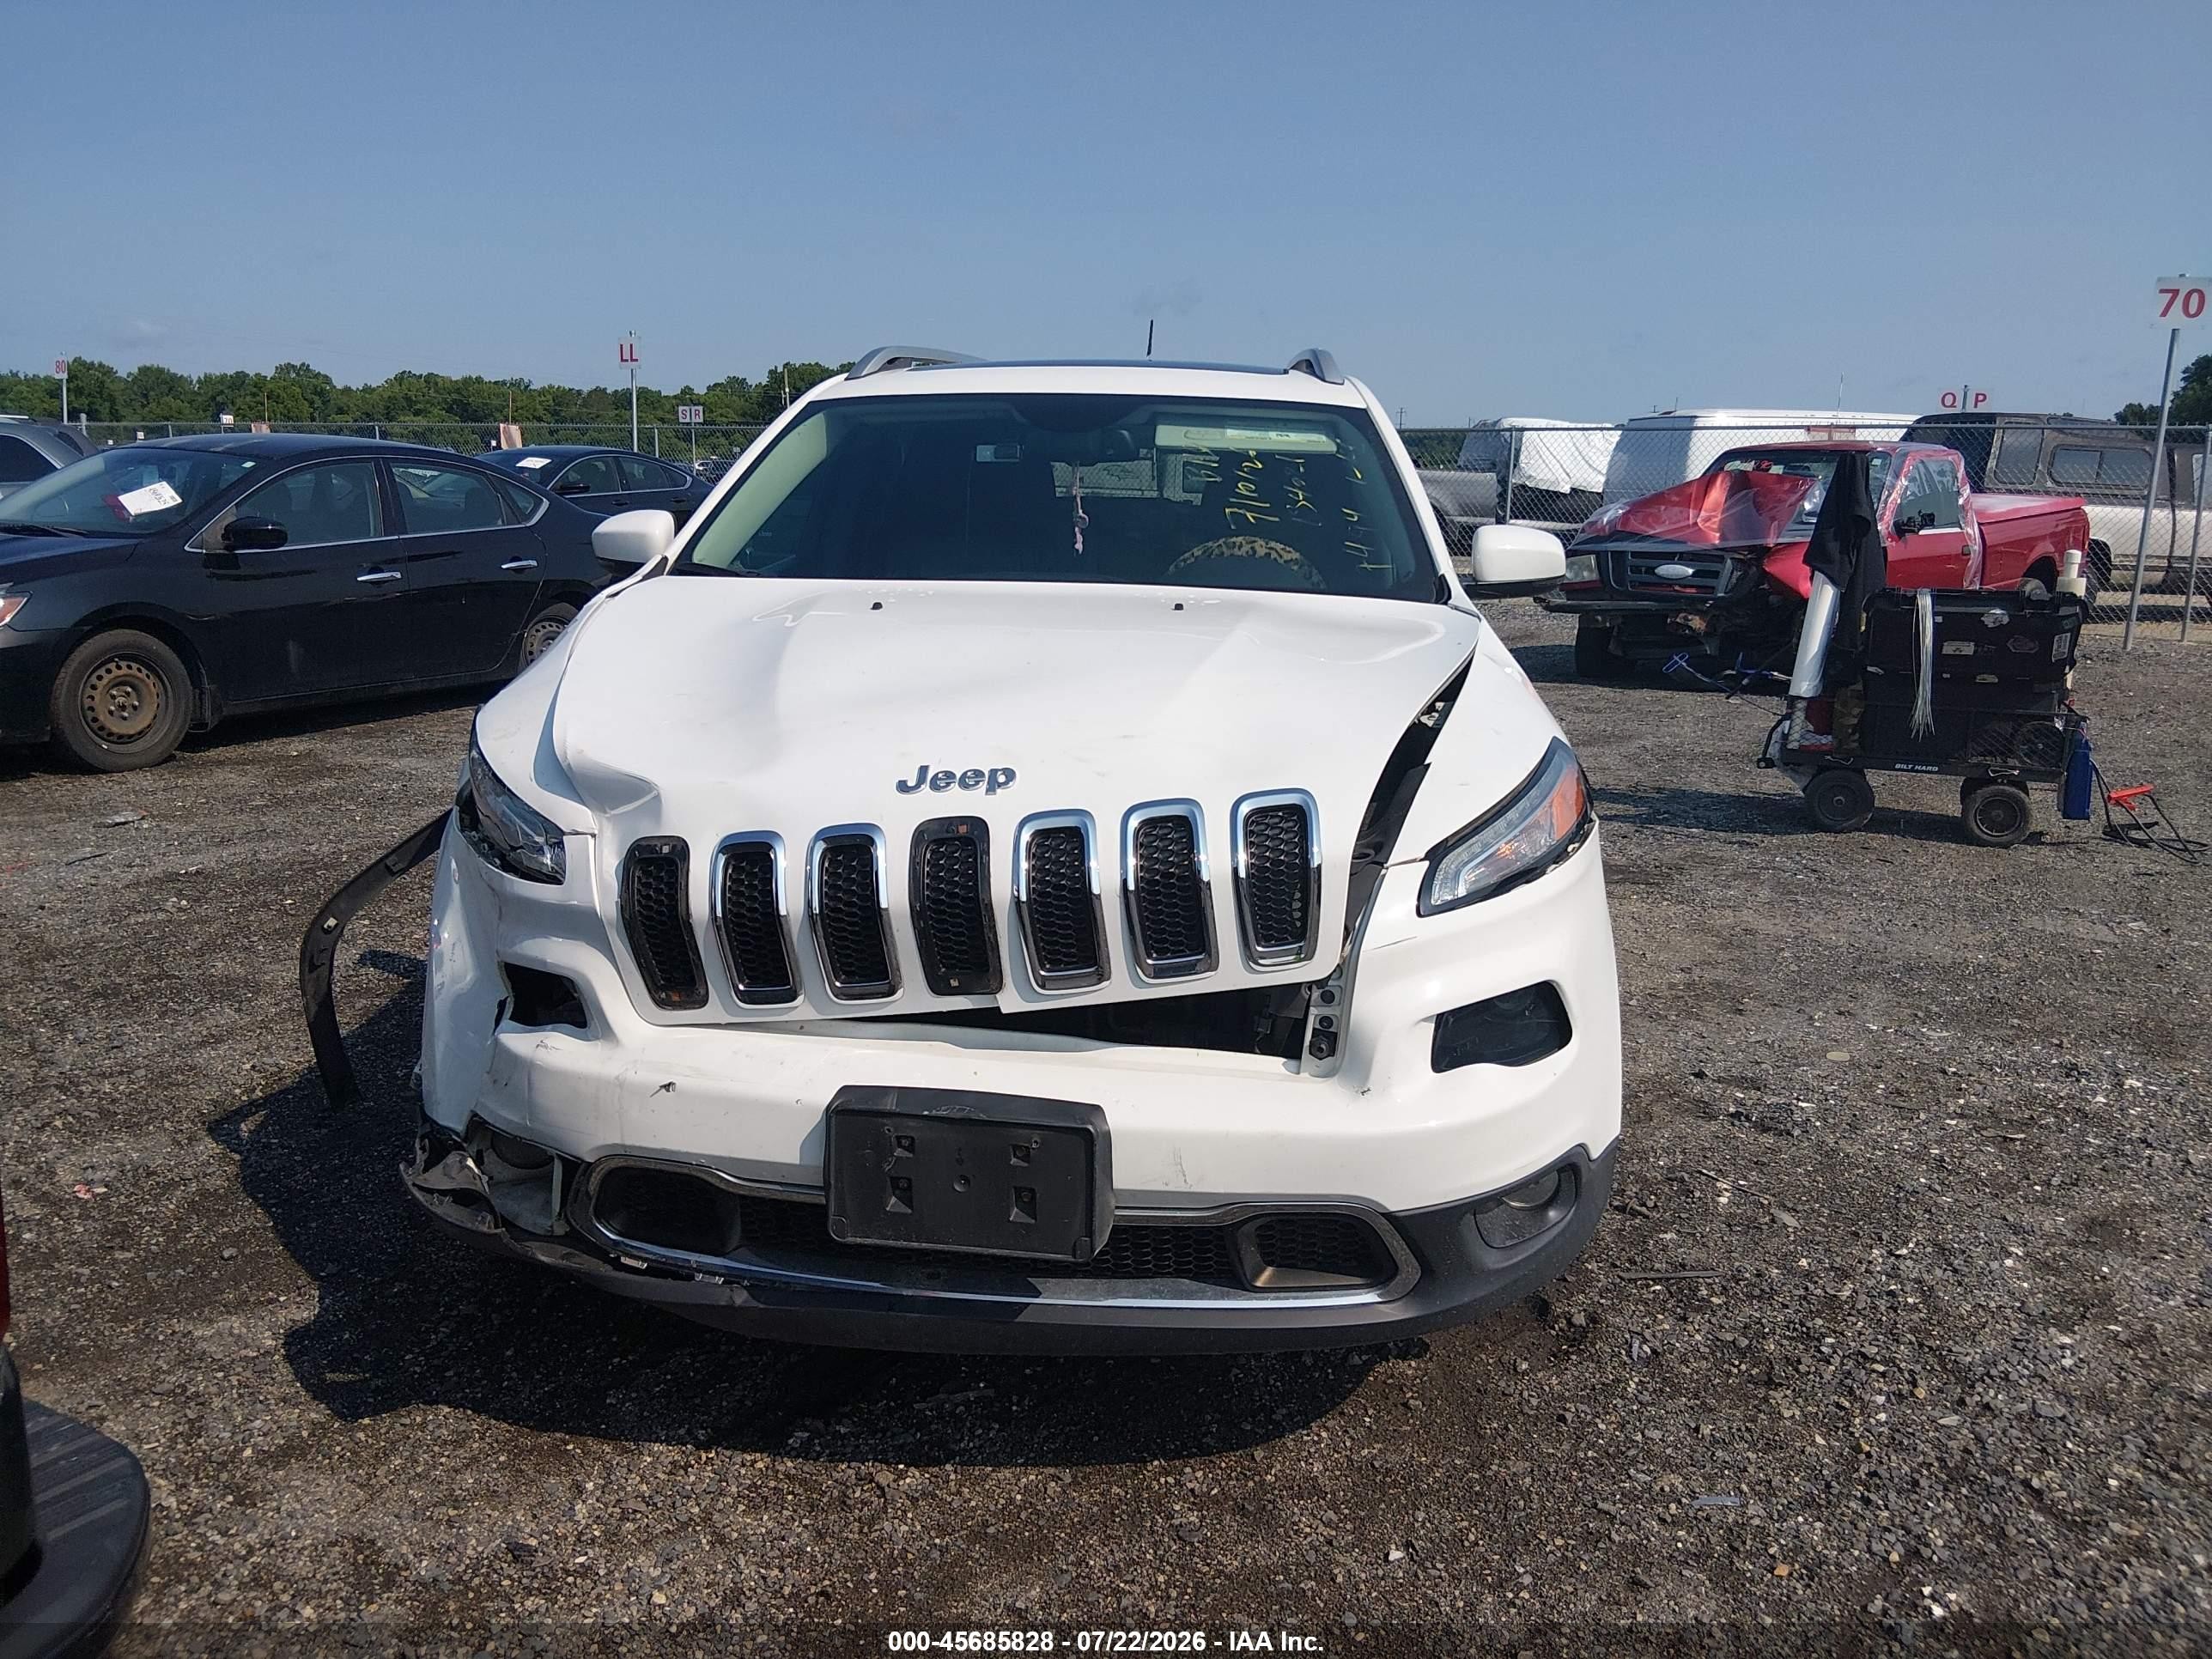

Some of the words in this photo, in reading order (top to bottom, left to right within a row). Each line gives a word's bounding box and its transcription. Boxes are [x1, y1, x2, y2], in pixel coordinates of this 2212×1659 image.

[2158, 288, 2206, 319] 70
[620, 343, 639, 362] LL
[55, 360, 66, 374] 80
[1941, 392, 1957, 409] Q
[1973, 392, 1987, 409] P
[681, 409, 688, 420] S
[694, 409, 701, 420] R
[896, 765, 1017, 795] Jeep
